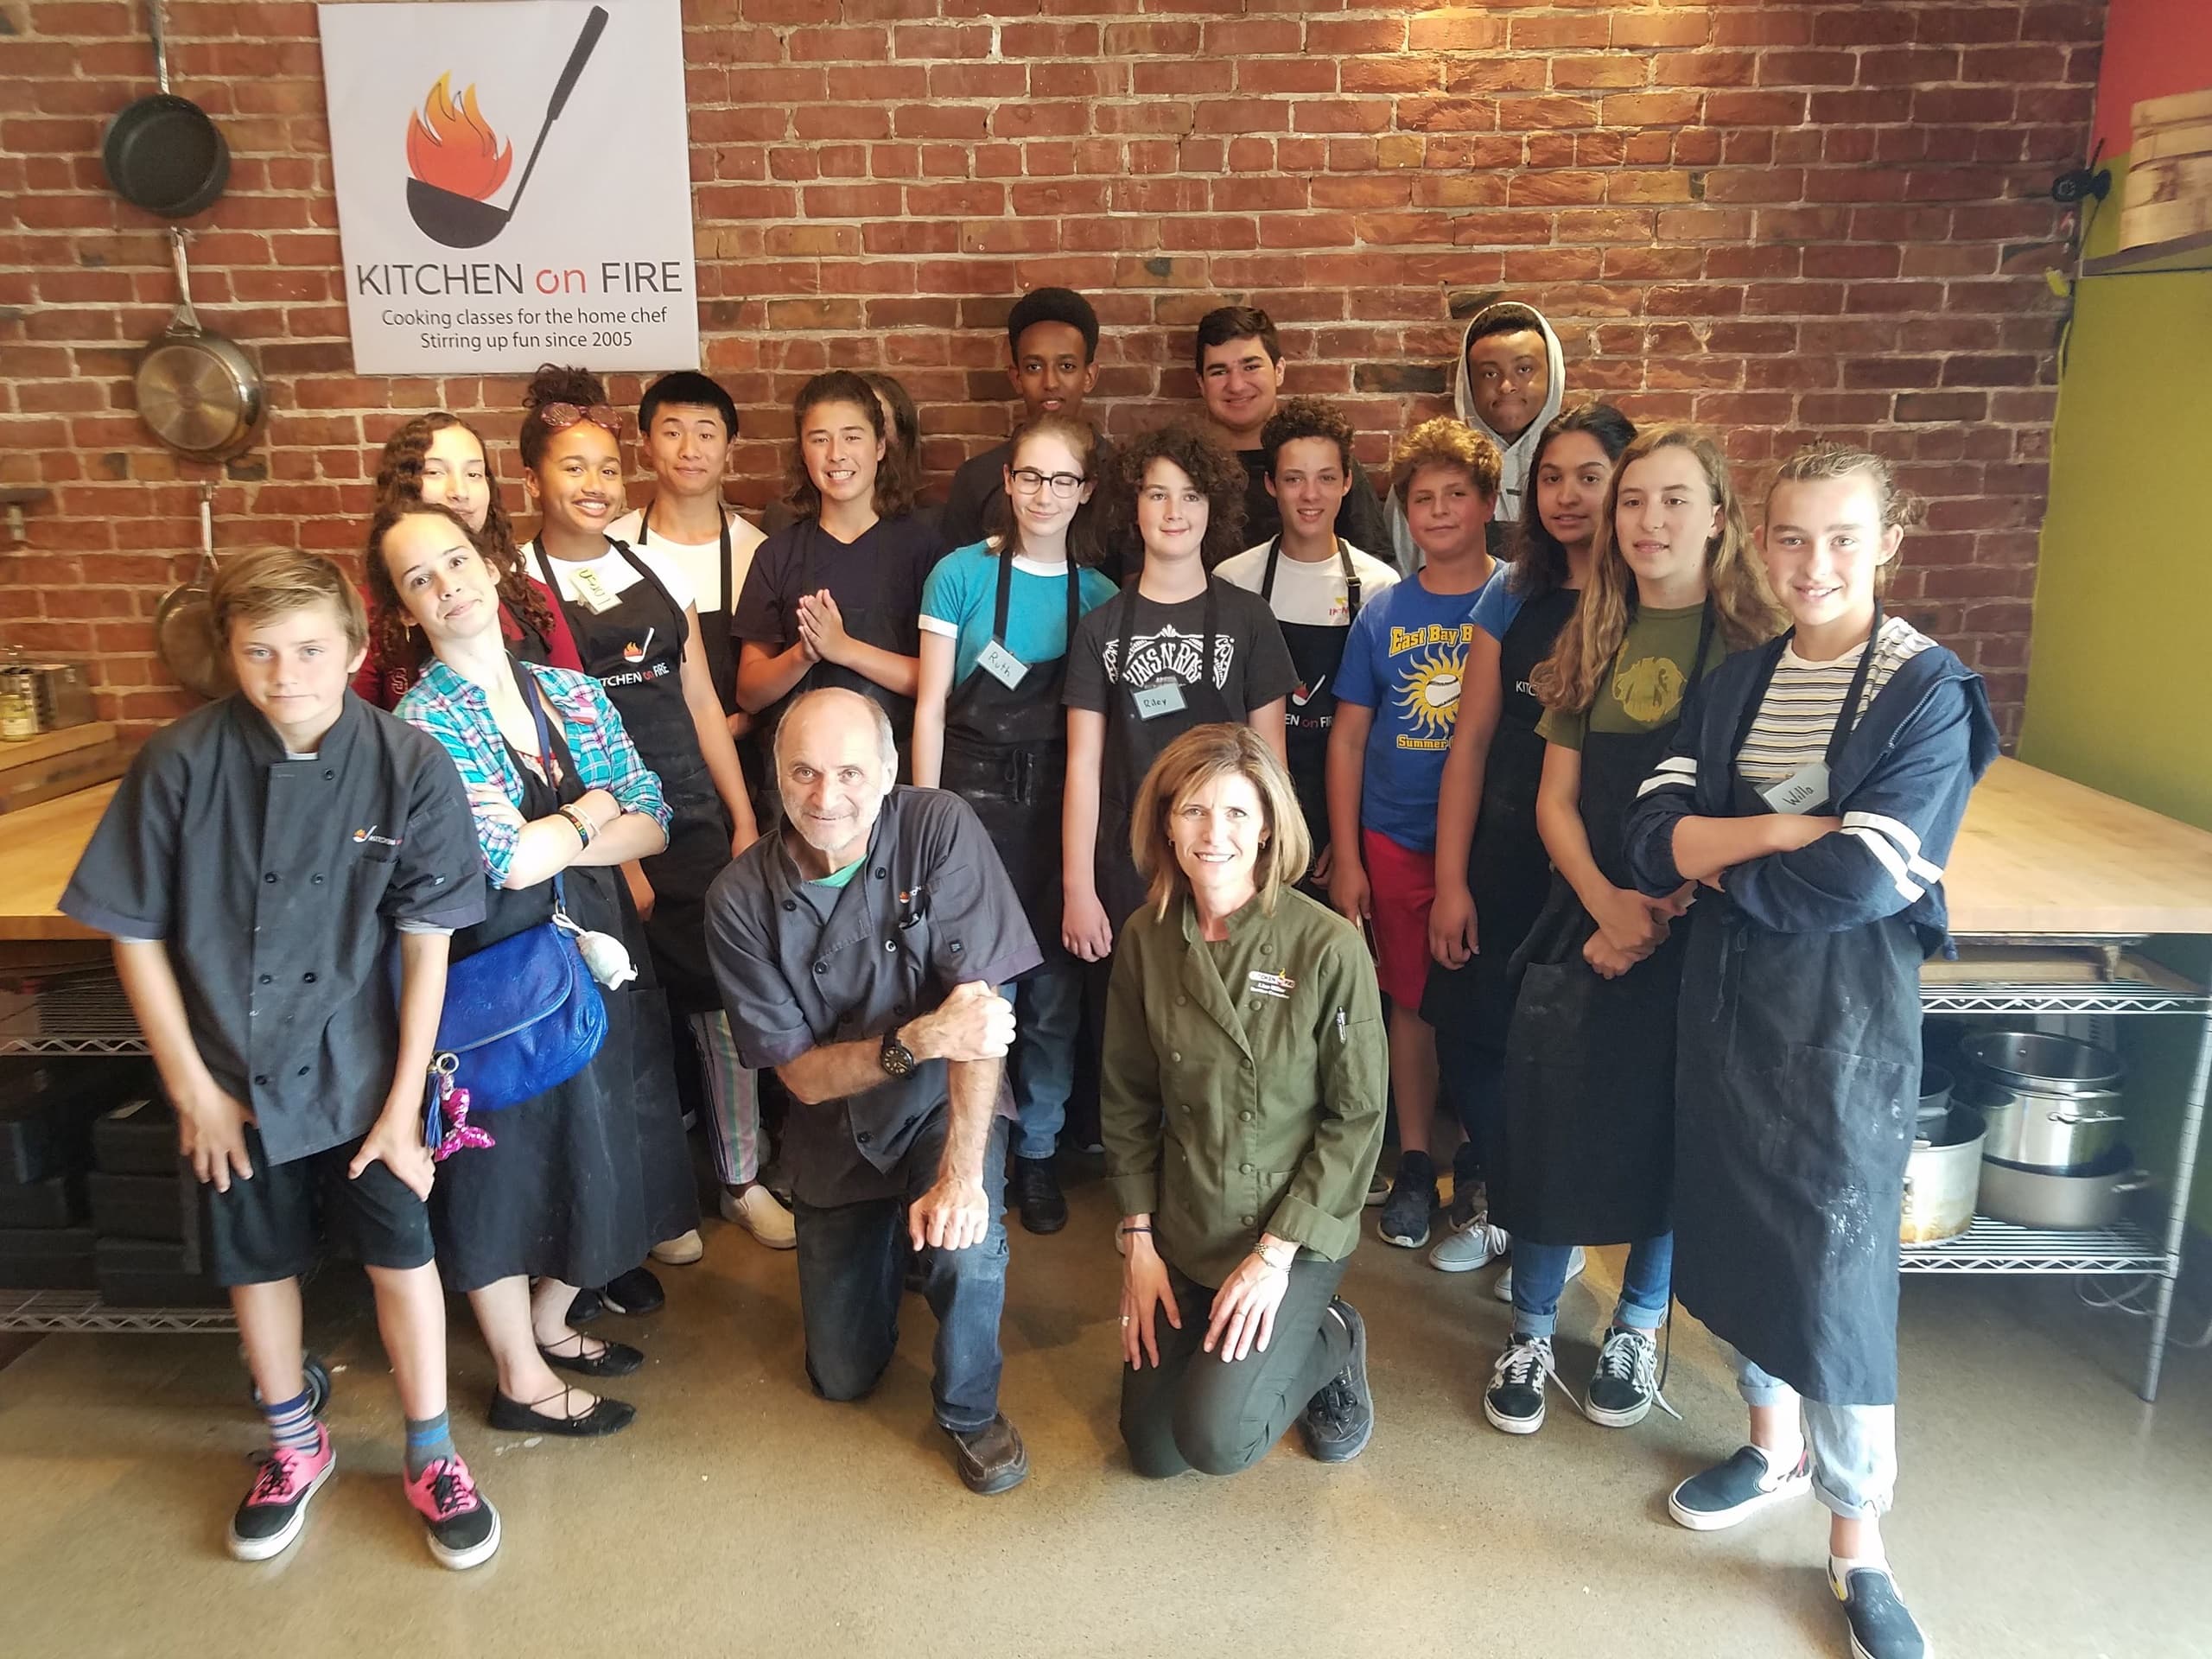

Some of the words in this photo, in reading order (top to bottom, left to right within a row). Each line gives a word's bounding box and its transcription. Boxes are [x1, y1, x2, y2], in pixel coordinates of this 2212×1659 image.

[357, 263, 524, 296] KITCHEN
[535, 268, 587, 295] on
[601, 261, 683, 294] FIRE
[382, 308, 452, 327] Cooking
[456, 308, 514, 325] classes
[518, 307, 543, 324] for
[545, 307, 573, 324] the
[577, 307, 626, 324] home
[631, 306, 667, 324] chef
[421, 333, 481, 352] Stirring
[486, 336, 508, 351] up
[513, 332, 541, 347] fun
[545, 332, 587, 347] since
[592, 331, 632, 346] 2005
[1389, 626, 1426, 656] East
[1427, 624, 1459, 647] Bay
[988, 651, 1010, 677] Ruth
[599, 671, 643, 687] TCHEN
[1516, 680, 1536, 696] KITC
[1396, 734, 1448, 750] Summer
[1782, 785, 1815, 805] Willa
